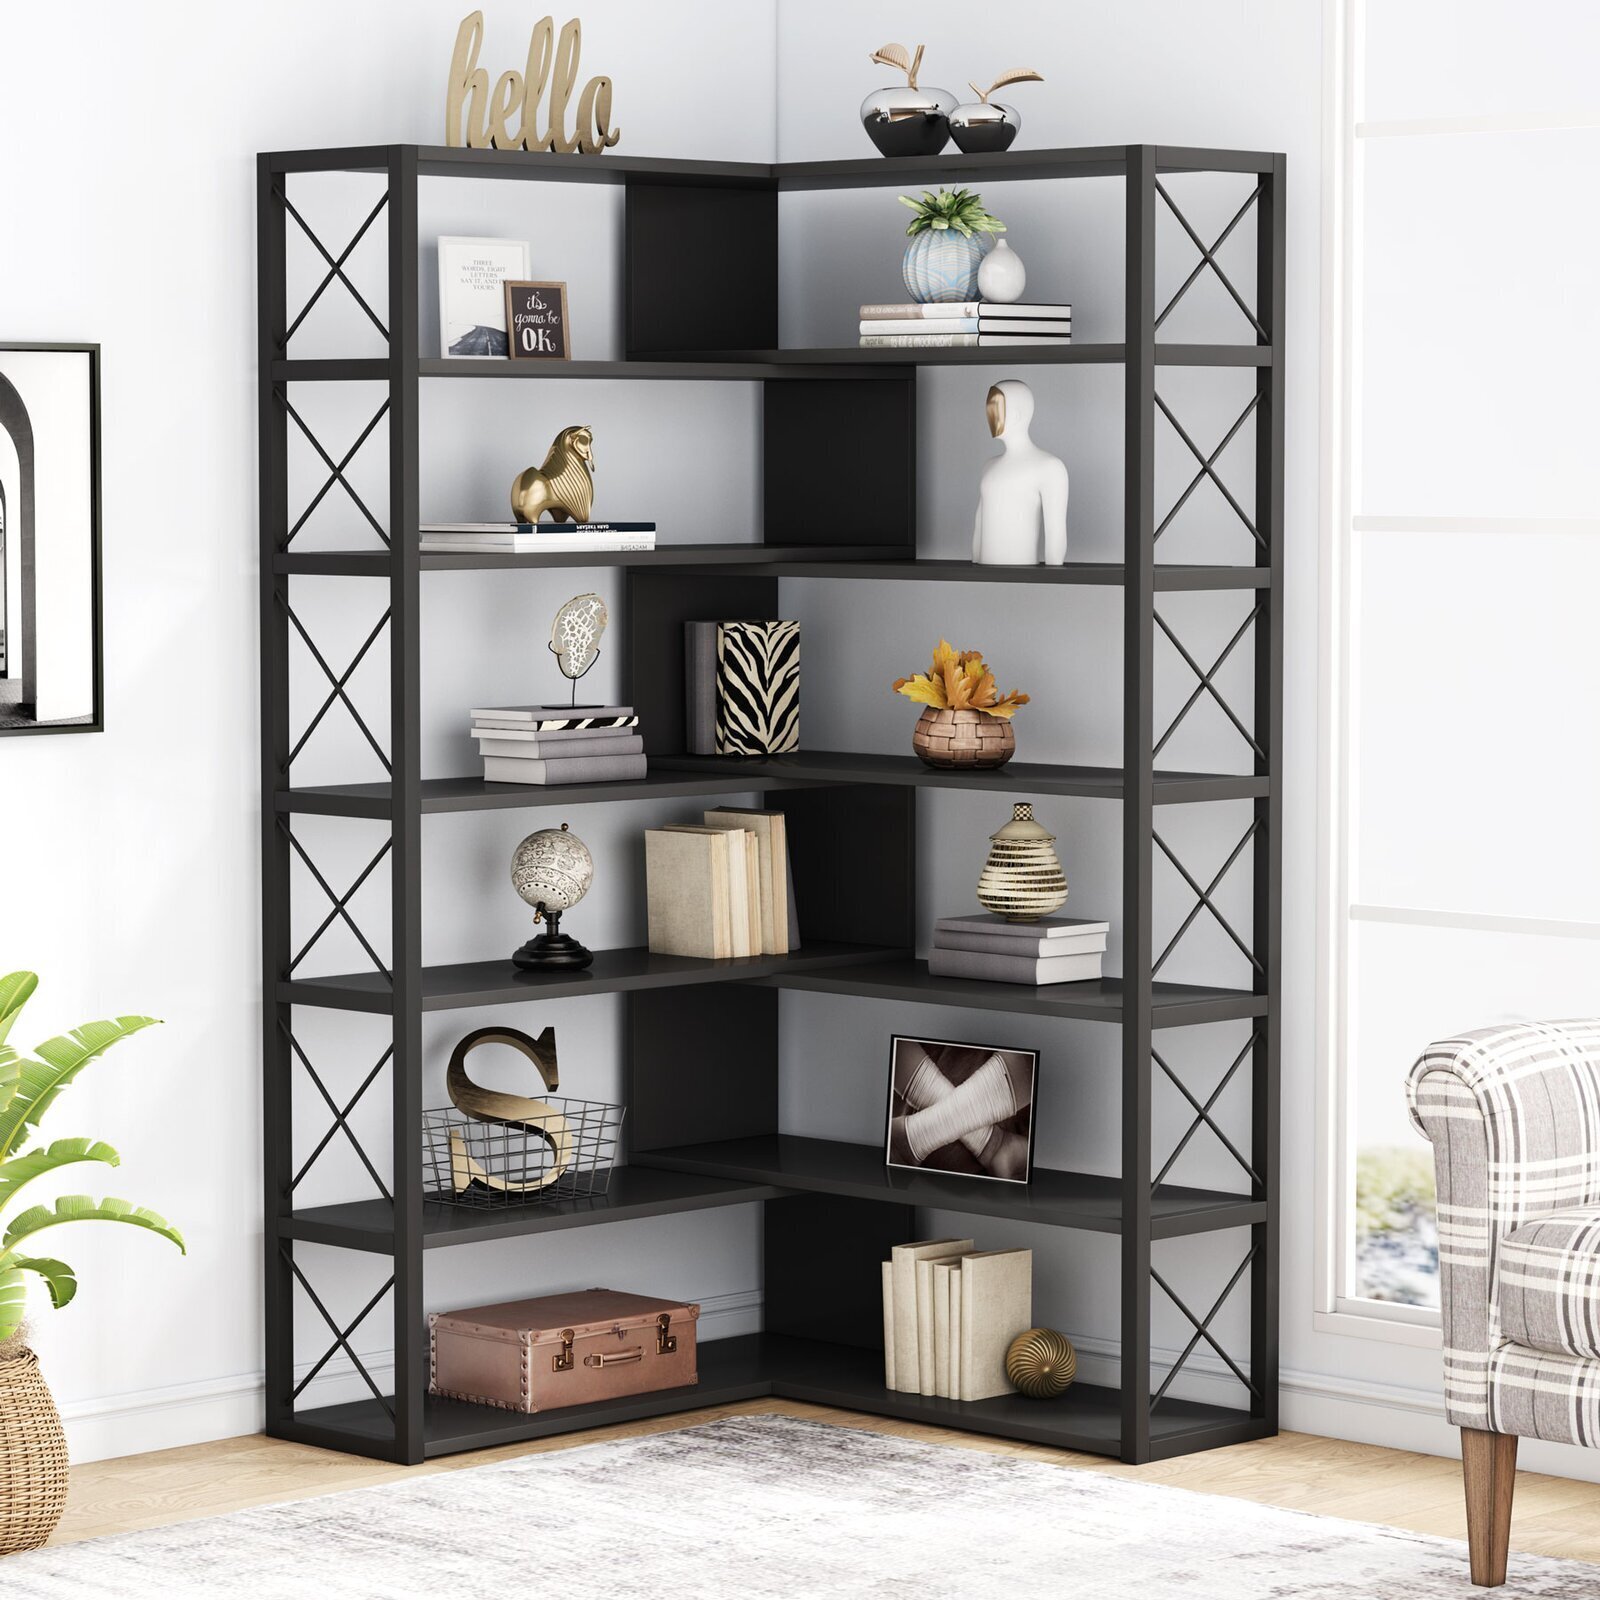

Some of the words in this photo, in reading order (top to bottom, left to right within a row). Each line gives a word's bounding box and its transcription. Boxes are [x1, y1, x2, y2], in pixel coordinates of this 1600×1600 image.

[446, 10, 620, 154] hello
[514, 313, 546, 332] gonna
[546, 310, 561, 324] be
[446, 1026, 573, 1198] S
